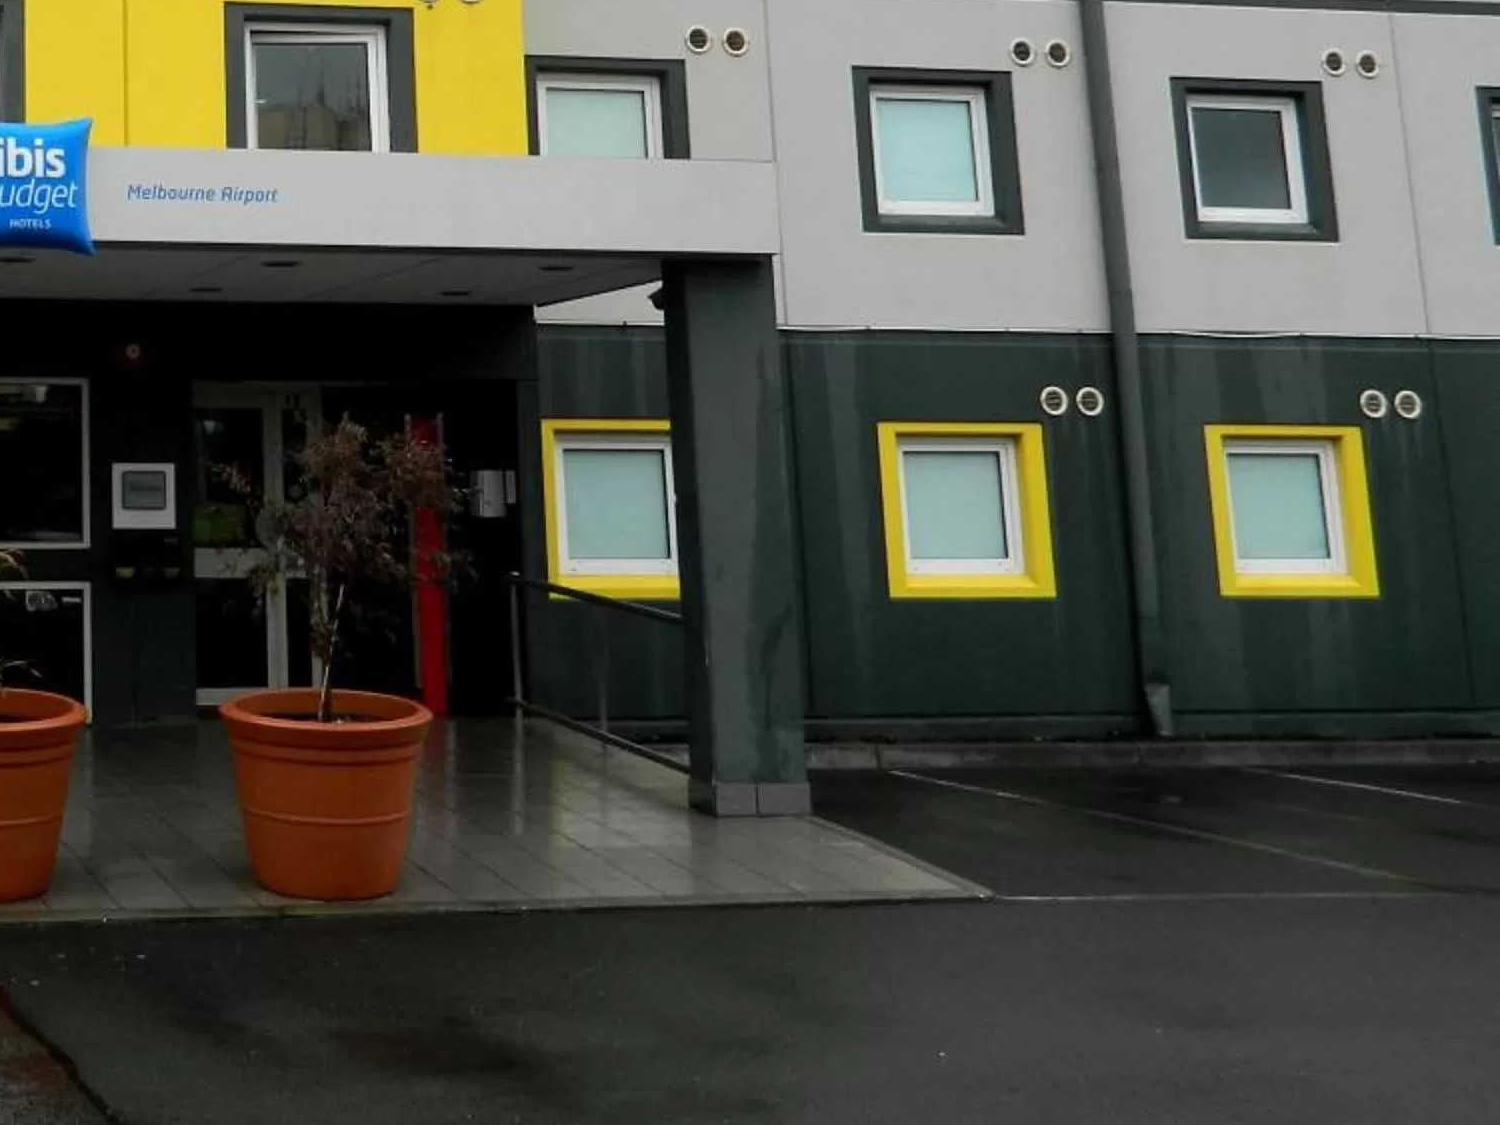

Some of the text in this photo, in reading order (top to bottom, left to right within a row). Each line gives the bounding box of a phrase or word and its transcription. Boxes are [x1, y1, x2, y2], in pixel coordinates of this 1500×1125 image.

[127, 184, 278, 205] Melbourne Airport
[9, 218, 52, 229] HOTELS
